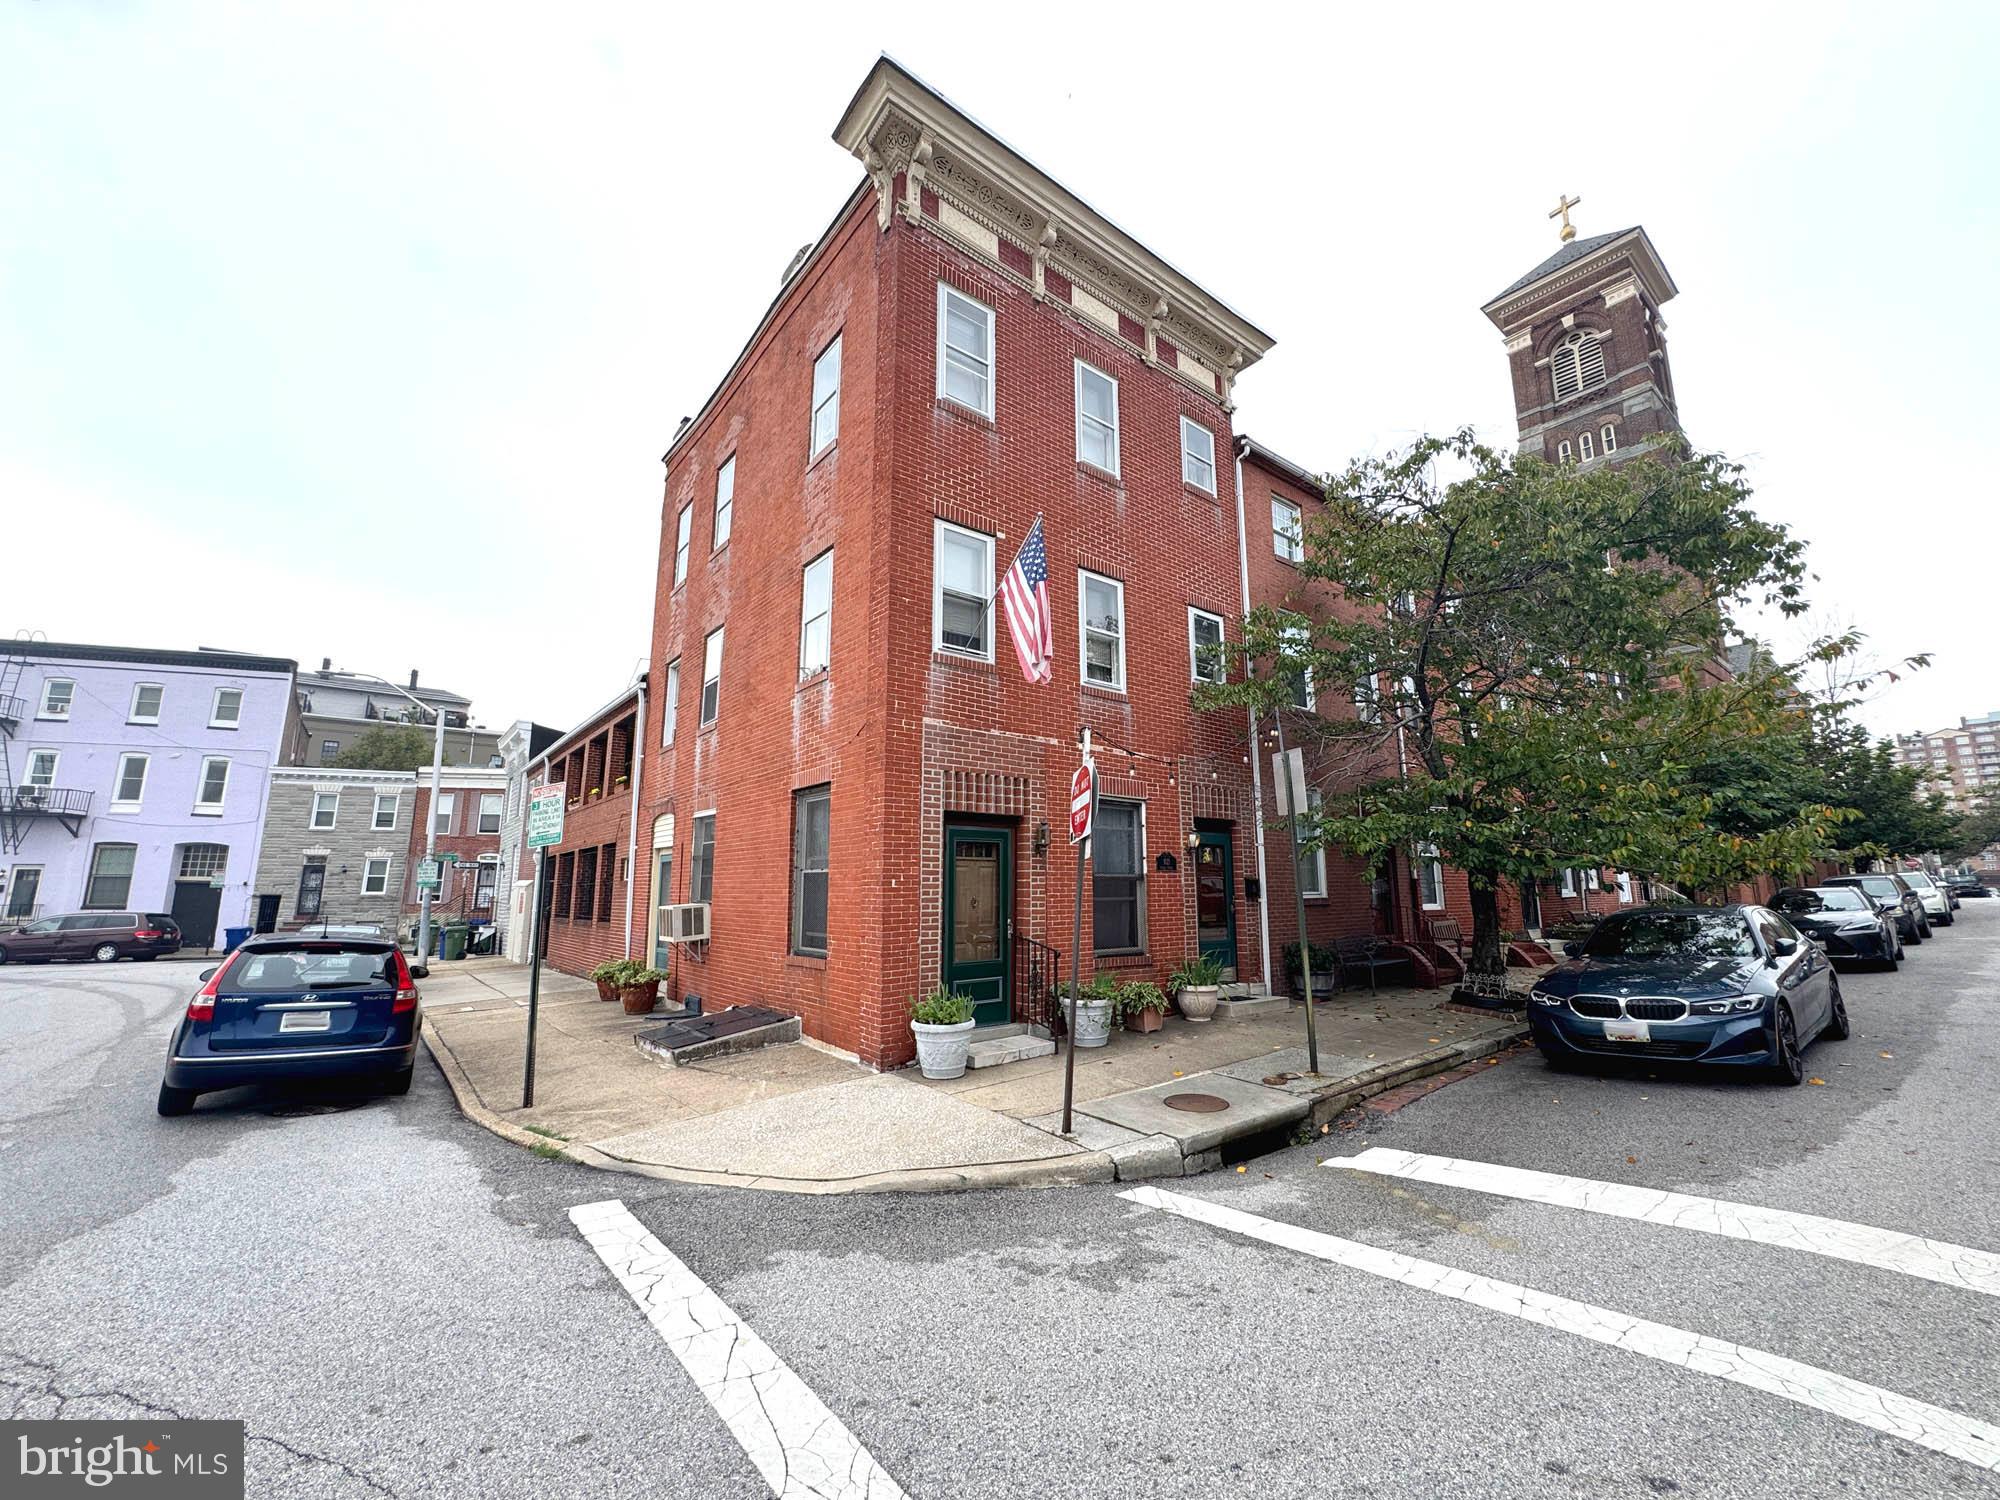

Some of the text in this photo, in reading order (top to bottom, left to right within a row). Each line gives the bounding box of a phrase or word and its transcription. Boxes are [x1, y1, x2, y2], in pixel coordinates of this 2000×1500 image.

[1073, 776, 1089, 796] DO NOT
[543, 799, 561, 808] HOUR
[1074, 809, 1086, 826] ENTER
